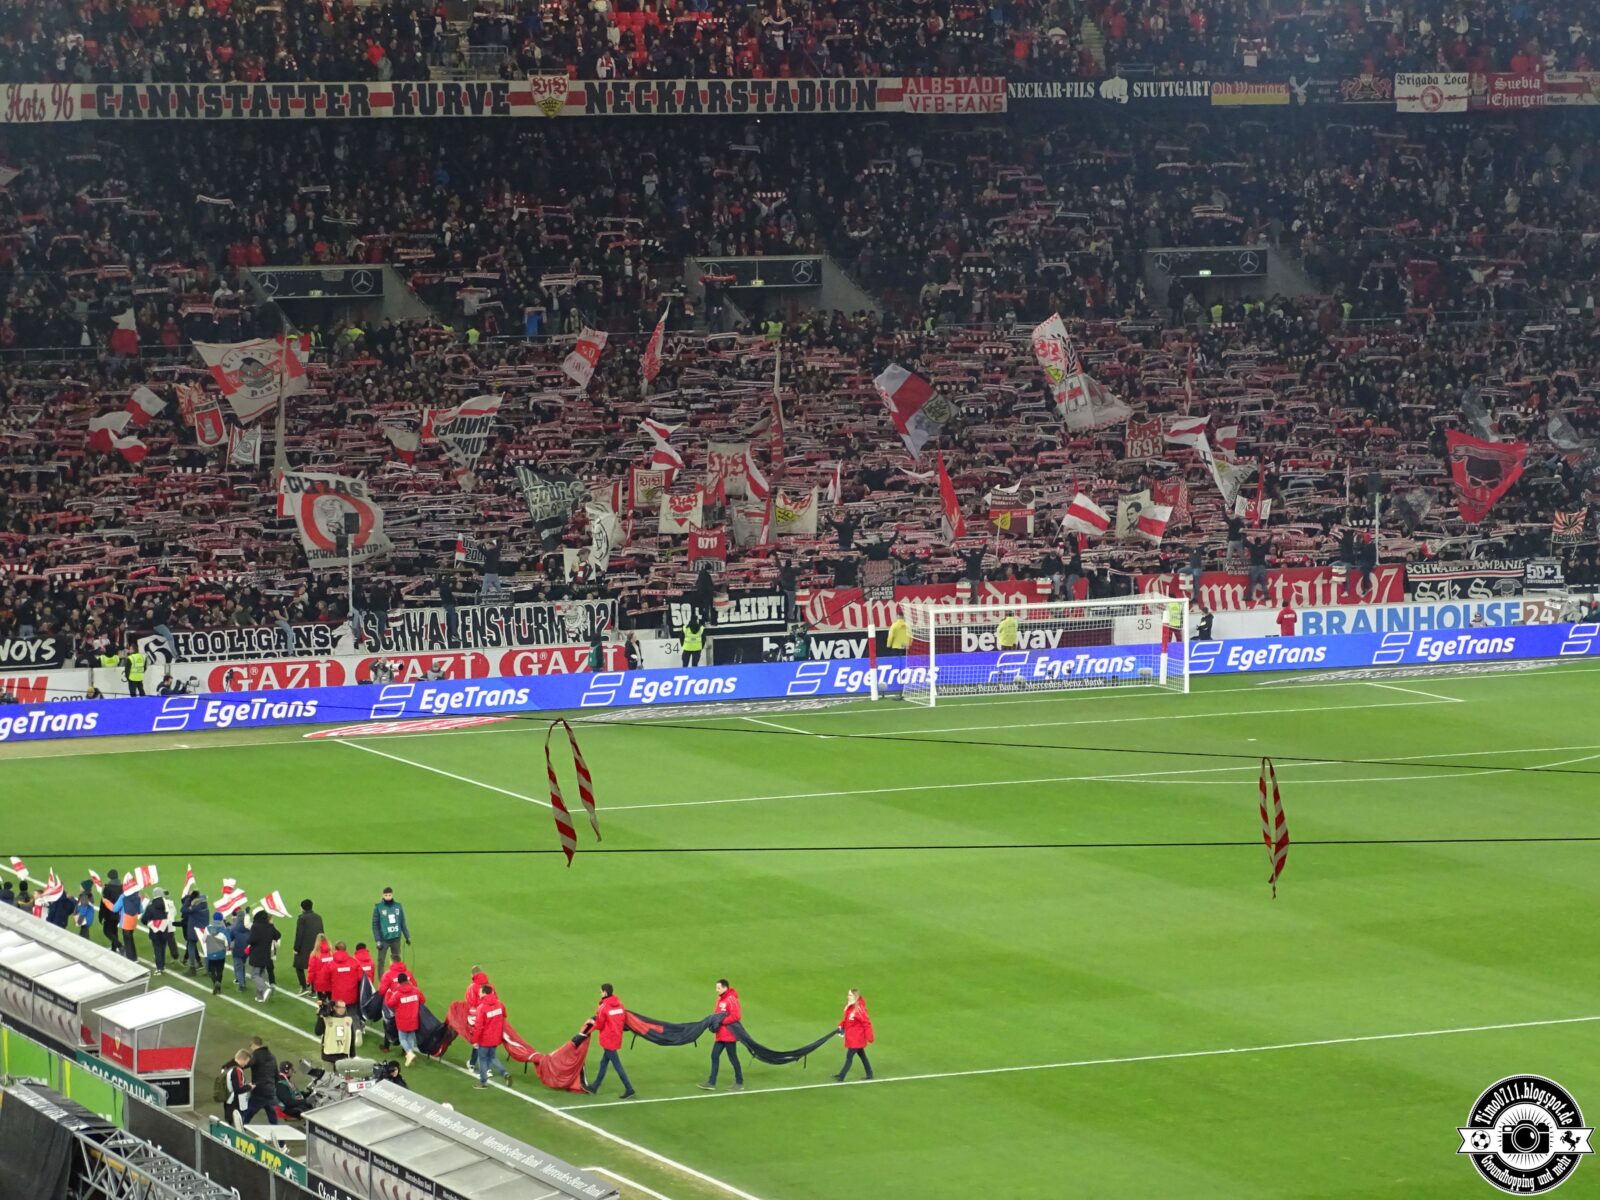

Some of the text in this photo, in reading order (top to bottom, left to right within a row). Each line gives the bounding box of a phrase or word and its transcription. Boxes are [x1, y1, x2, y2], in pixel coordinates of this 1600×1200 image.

[907, 77, 1006, 94] ALBSTADT
[1007, 80, 1210, 98] NECKAR-FILS STUTTGART
[1397, 74, 1467, 87] Brigada Loca
[1494, 78, 1540, 90] Suebia
[51, 83, 74, 121] 96
[96, 82, 510, 119] CANNSTATTER KURVE
[585, 79, 877, 115] NECKARSTADION
[909, 95, 1004, 112] VFB-FANS
[1127, 436, 1163, 458] 1893
[1526, 564, 1564, 579] 50+1
[717, 596, 786, 623] BLEIBT!
[1302, 602, 1520, 635] BRAINHOUSE
[1137, 619, 1152, 631] 35
[174, 624, 330, 655] HOOLIGANS
[961, 627, 1064, 653] beway
[1416, 635, 1515, 661] EgeTrans
[1033, 654, 1136, 680] EgeTrans
[1227, 643, 1326, 671] EgeTrans
[420, 686, 530, 714] EgeTrans
[629, 675, 737, 703] EgeTrans
[204, 698, 318, 727] EgeTrans
